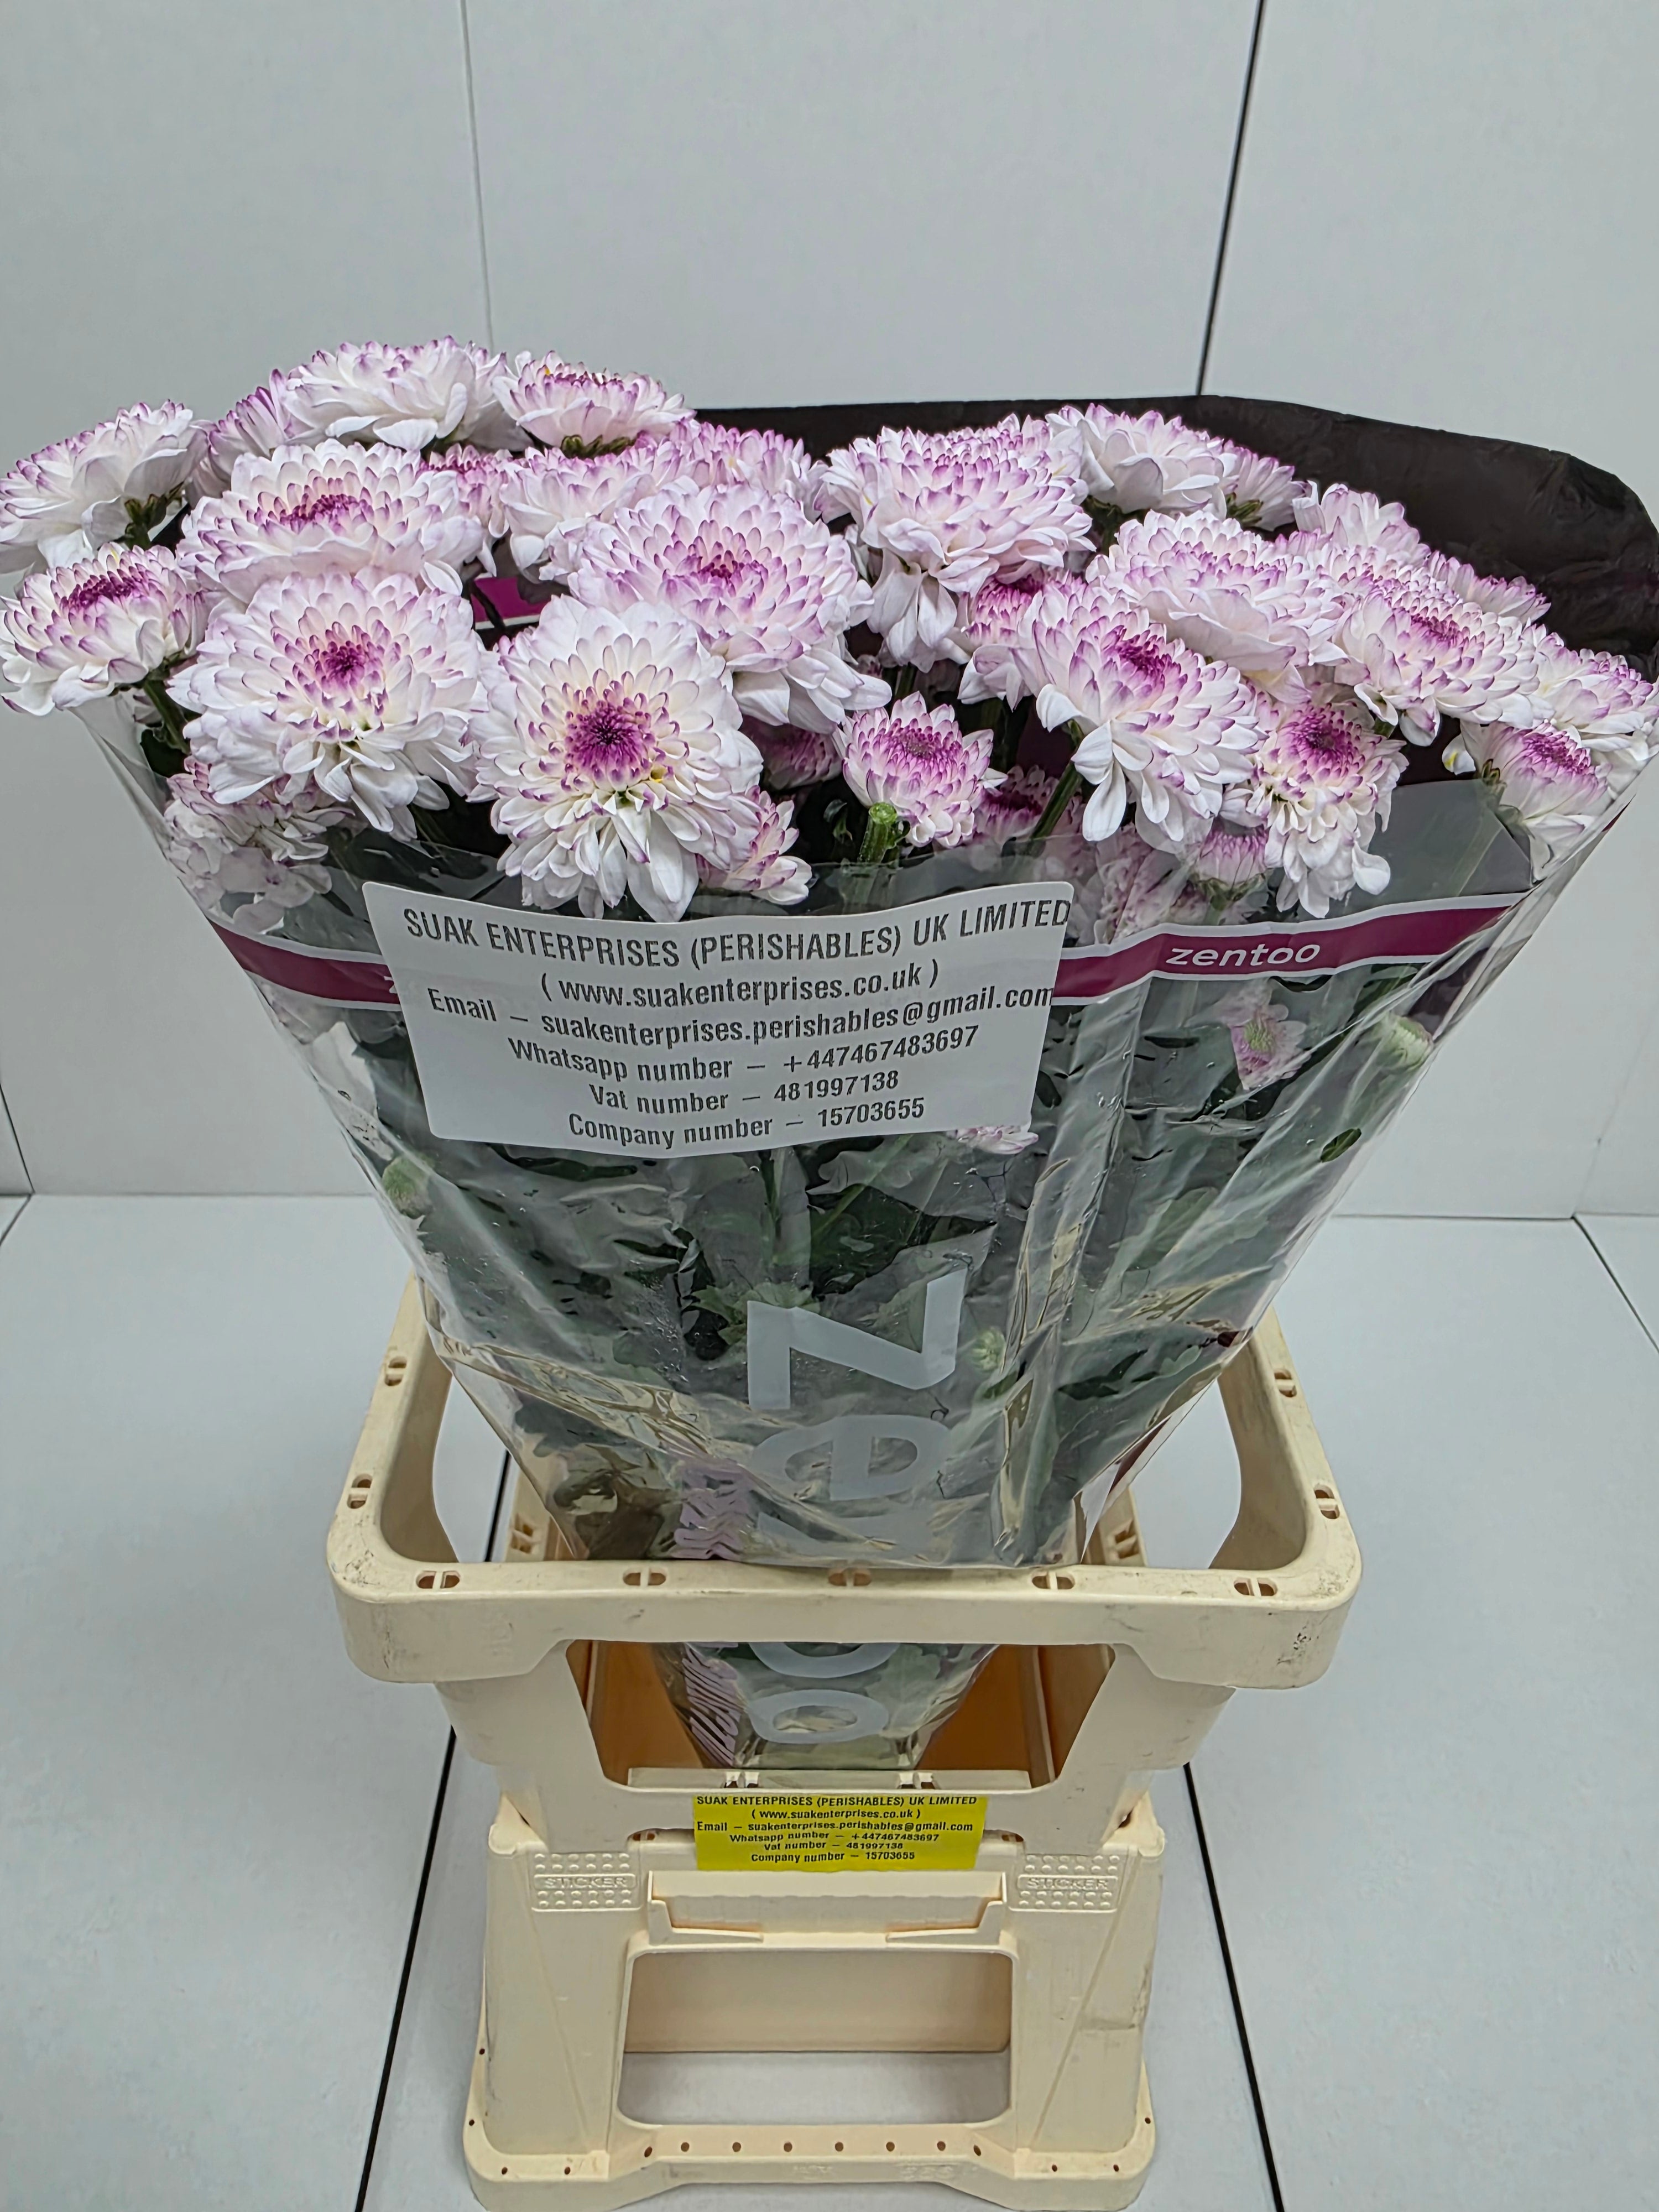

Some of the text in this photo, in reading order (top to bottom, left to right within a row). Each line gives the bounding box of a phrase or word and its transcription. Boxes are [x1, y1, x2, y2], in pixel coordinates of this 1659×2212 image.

[403, 899, 1071, 971] SUAK ENTERPRISES (PERISHABLES) UK LIMITED
[1165, 942, 1321, 967] zentoo
[541, 958, 939, 1009] ( www.suakenterprises.co.uk )
[426, 987, 498, 1022] Email
[540, 985, 1054, 1051] suakenterprises.perishables@gmail.com
[507, 1036, 628, 1083] Whatsapp
[637, 1056, 733, 1083] number
[782, 1024, 979, 1073] +447467483697
[588, 1083, 629, 1111] Vat
[637, 1092, 729, 1115] number
[773, 1070, 899, 1102] 481997138
[568, 1113, 675, 1151] Company
[683, 1117, 773, 1144] number
[817, 1096, 925, 1128] 15703655
[697, 1796, 977, 1808] SUAK ENTERPRISES (PERISHABLES) UK LIMITED
[752, 1809, 755, 1819] (
[916, 1809, 921, 1819] )
[697, 1821, 727, 1831] Email
[788, 1831, 830, 1839] number
[785, 1841, 826, 1849] number
[751, 1854, 800, 1864] Company
[804, 1852, 845, 1862] number
[544, 1877, 628, 1890] STICKER
